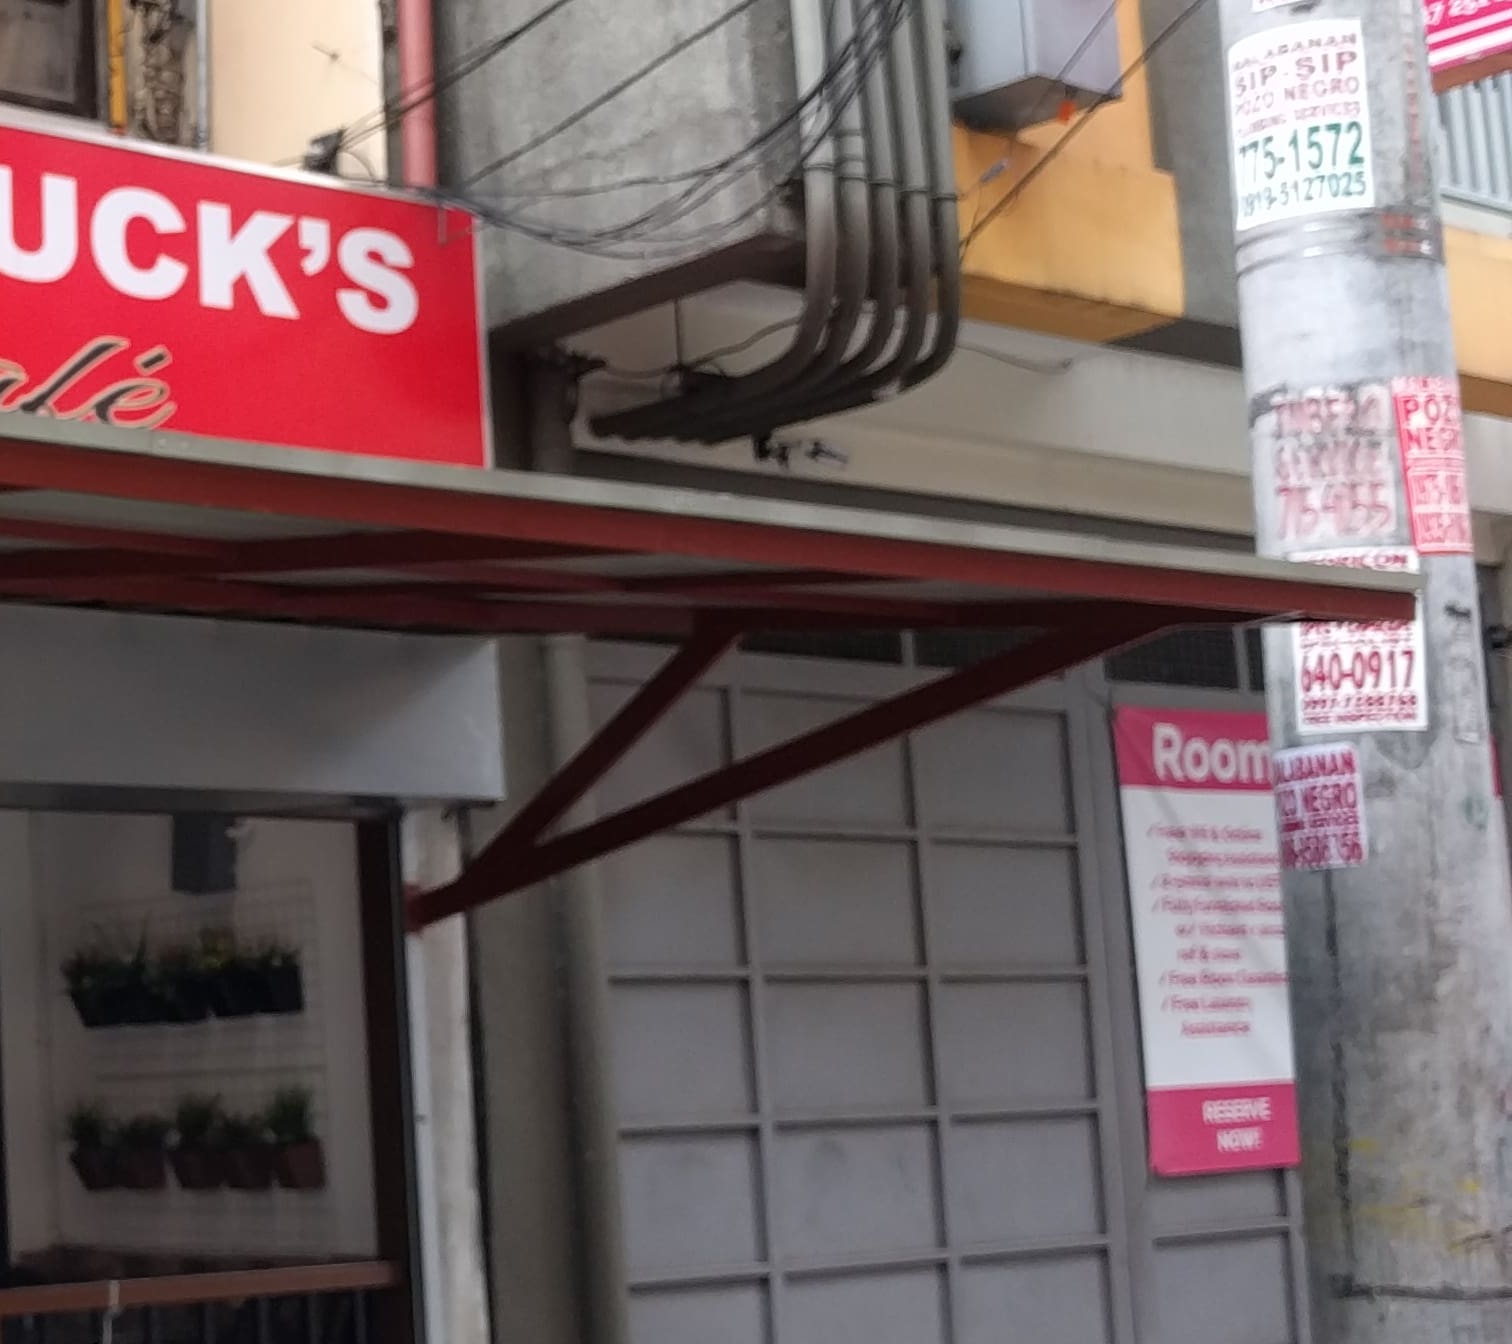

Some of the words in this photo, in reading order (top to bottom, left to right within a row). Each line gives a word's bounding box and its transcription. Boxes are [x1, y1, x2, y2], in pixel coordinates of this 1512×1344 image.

[1236, 64, 1278, 98] SIP
[1295, 50, 1358, 81] SIP
[1284, 75, 1360, 102] NEGRO
[1300, 649, 1415, 693] 640-0917
